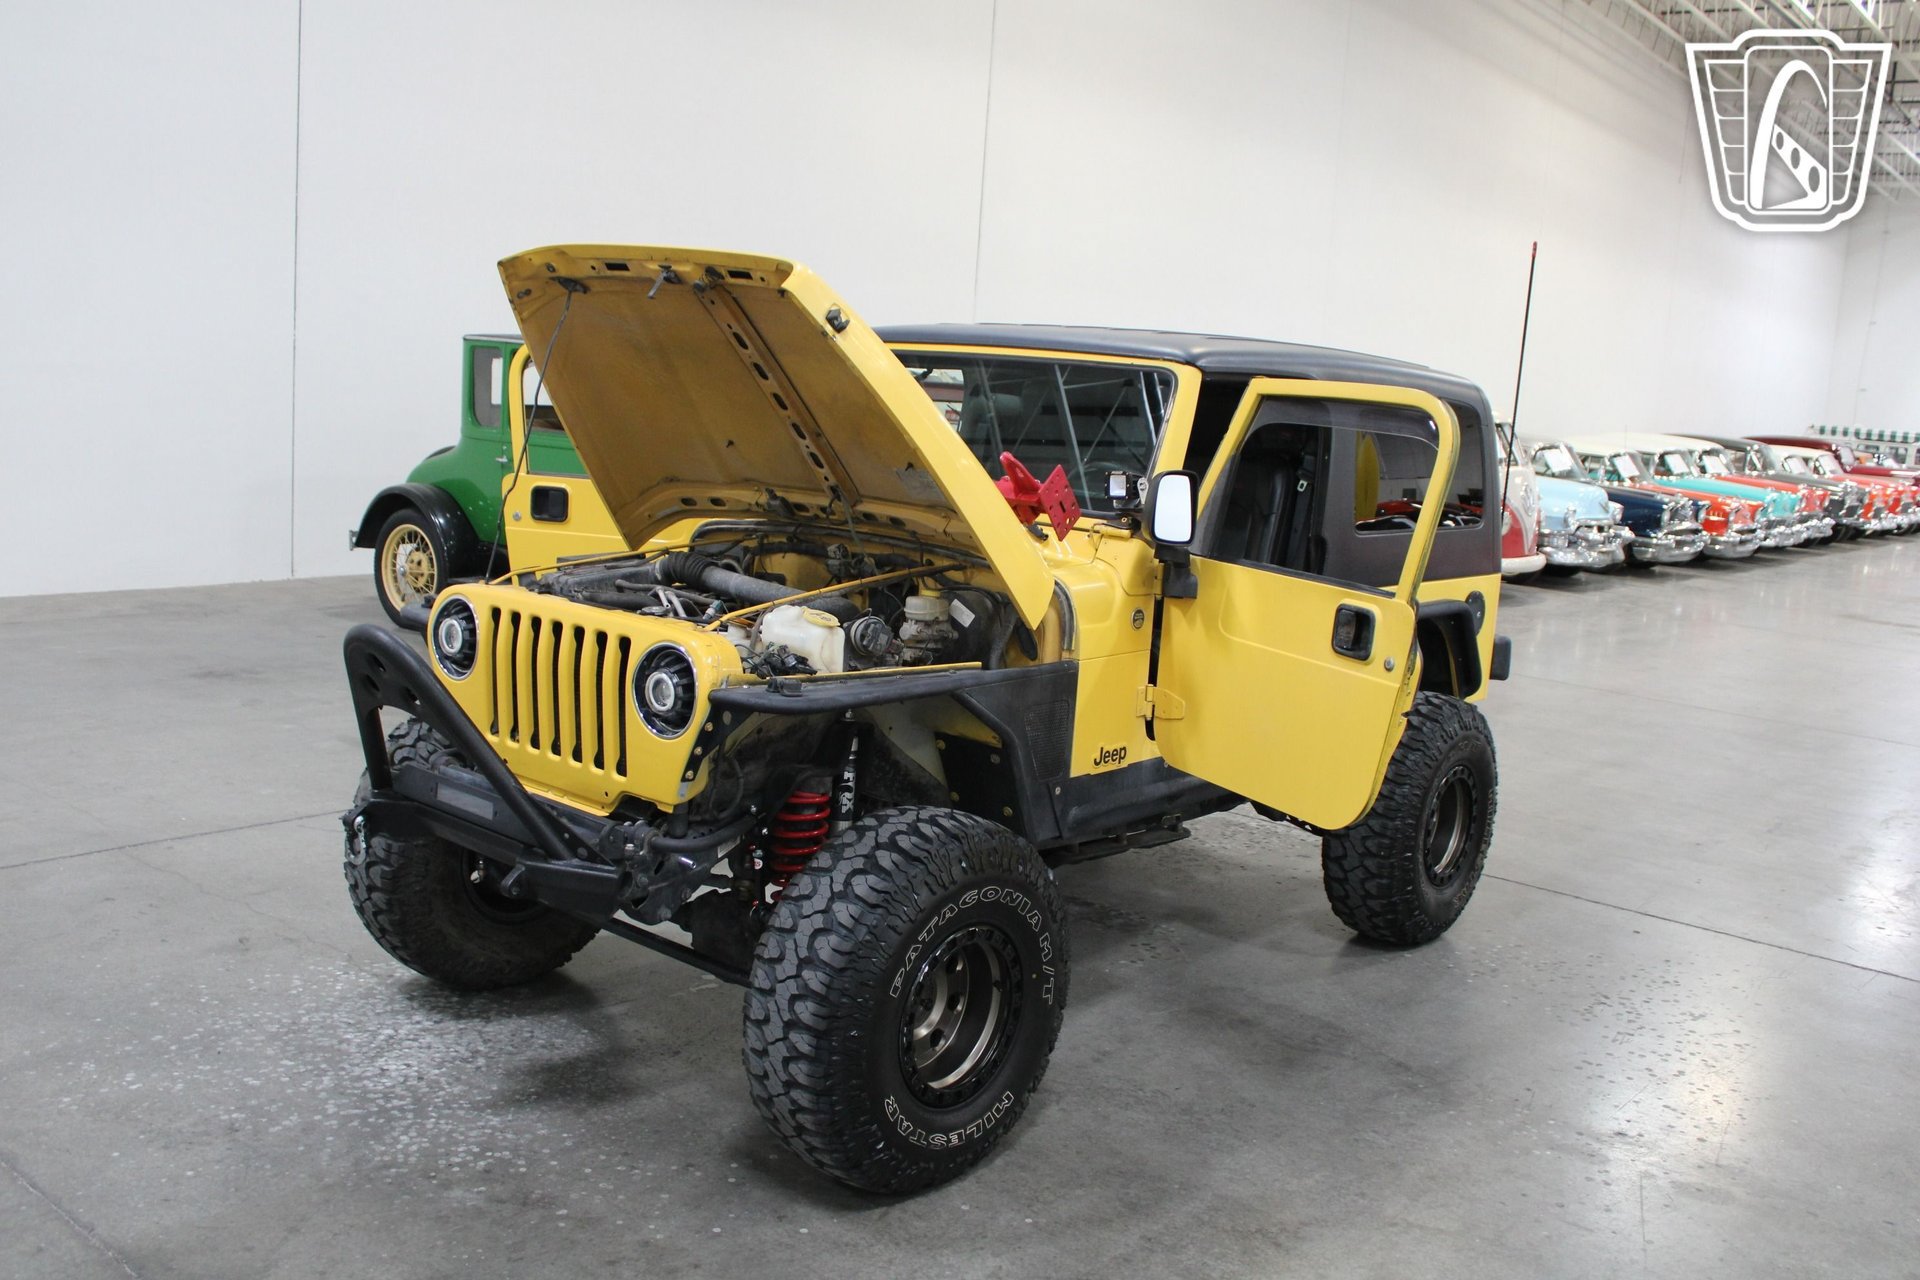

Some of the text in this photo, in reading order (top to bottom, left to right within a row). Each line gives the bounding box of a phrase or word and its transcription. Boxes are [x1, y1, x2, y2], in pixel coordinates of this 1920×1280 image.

[1094, 746, 1127, 766] Jeep
[889, 886, 1055, 1005] PATAGONIA M/T
[884, 1090, 1015, 1150] MILLESTAR
